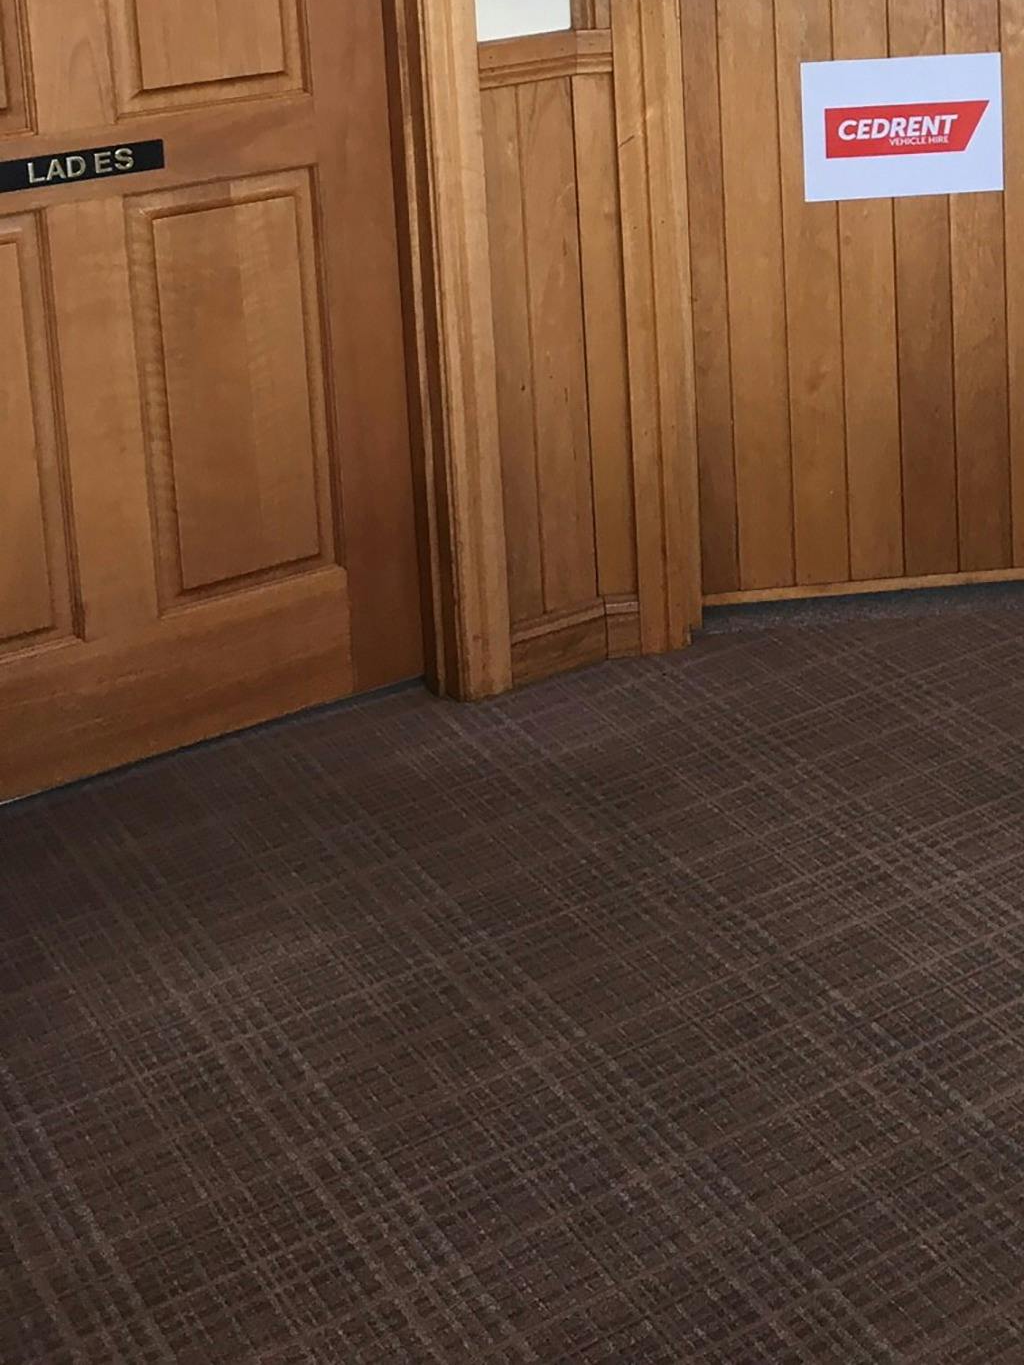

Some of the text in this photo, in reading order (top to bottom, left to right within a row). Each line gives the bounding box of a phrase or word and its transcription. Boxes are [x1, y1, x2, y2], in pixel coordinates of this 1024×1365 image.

[837, 114, 958, 141] CEDRENT
[889, 135, 949, 147] VEHICLE HIRE
[27, 147, 135, 184] LADES
